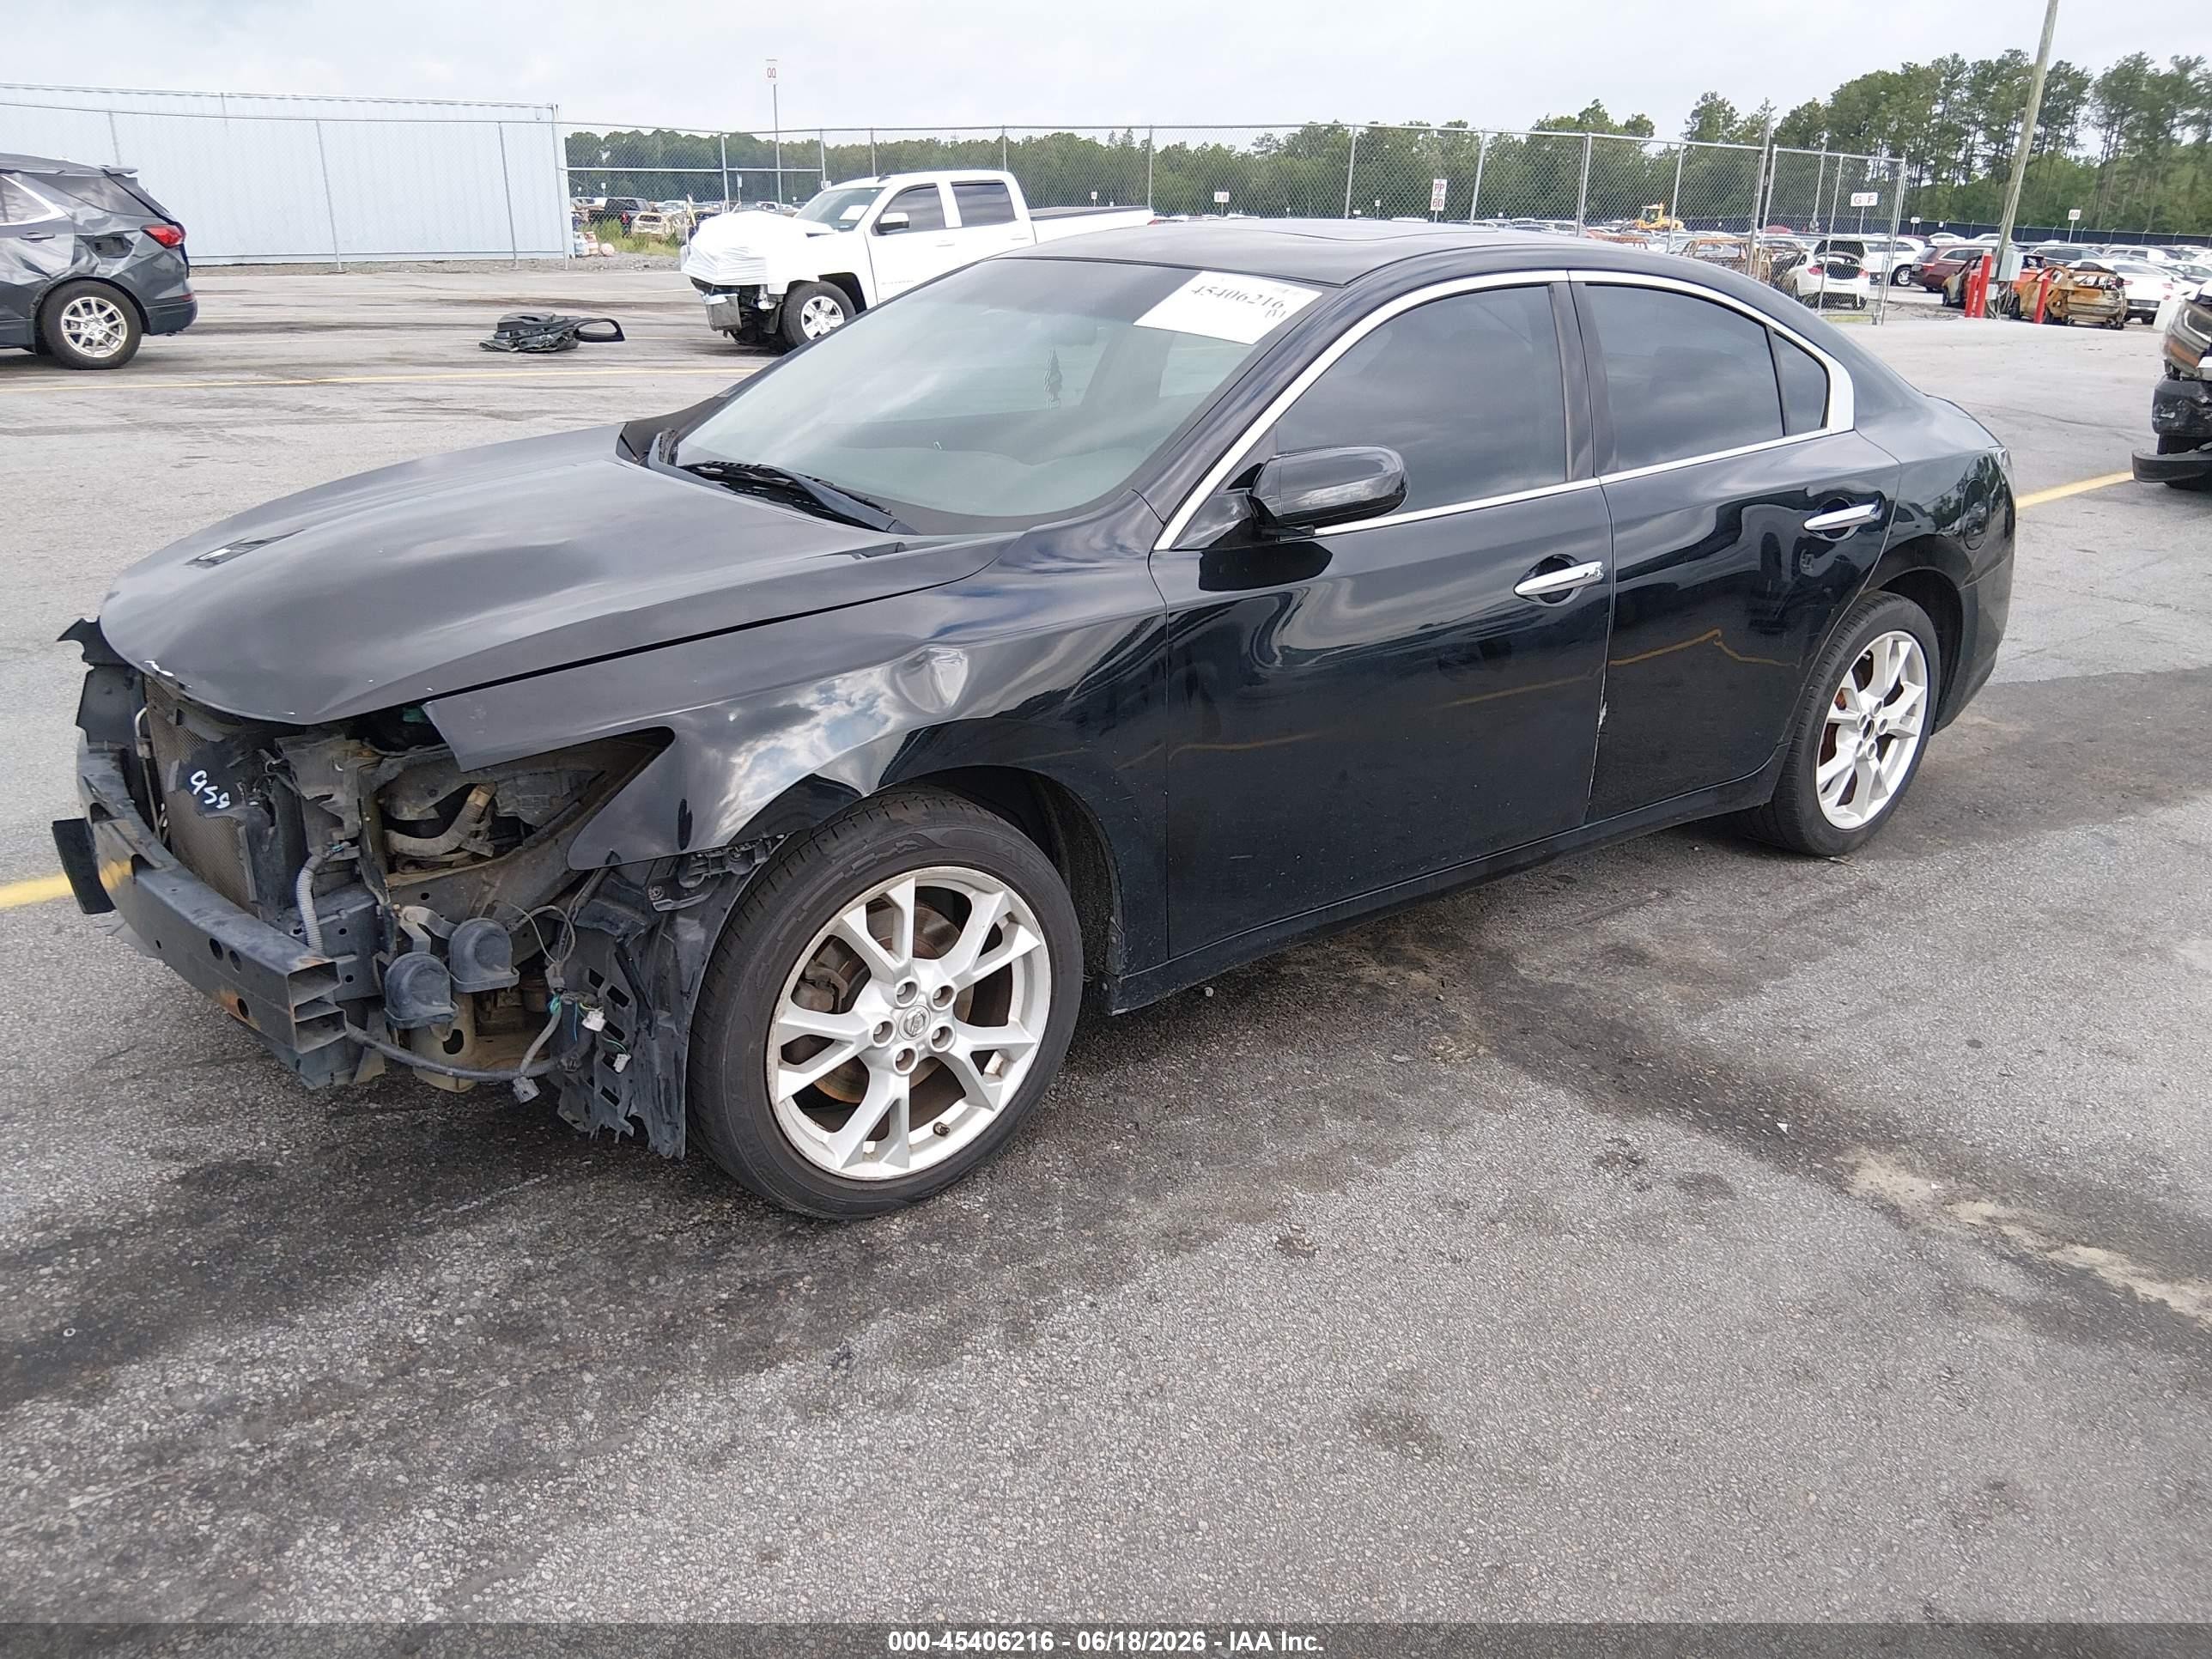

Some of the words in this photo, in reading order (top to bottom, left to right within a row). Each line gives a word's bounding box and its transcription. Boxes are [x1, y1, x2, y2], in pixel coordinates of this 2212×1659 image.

[1432, 198, 1443, 208] 60
[1854, 195, 1862, 204] G
[1868, 195, 1875, 204] F
[1192, 285, 1285, 309] 45406216
